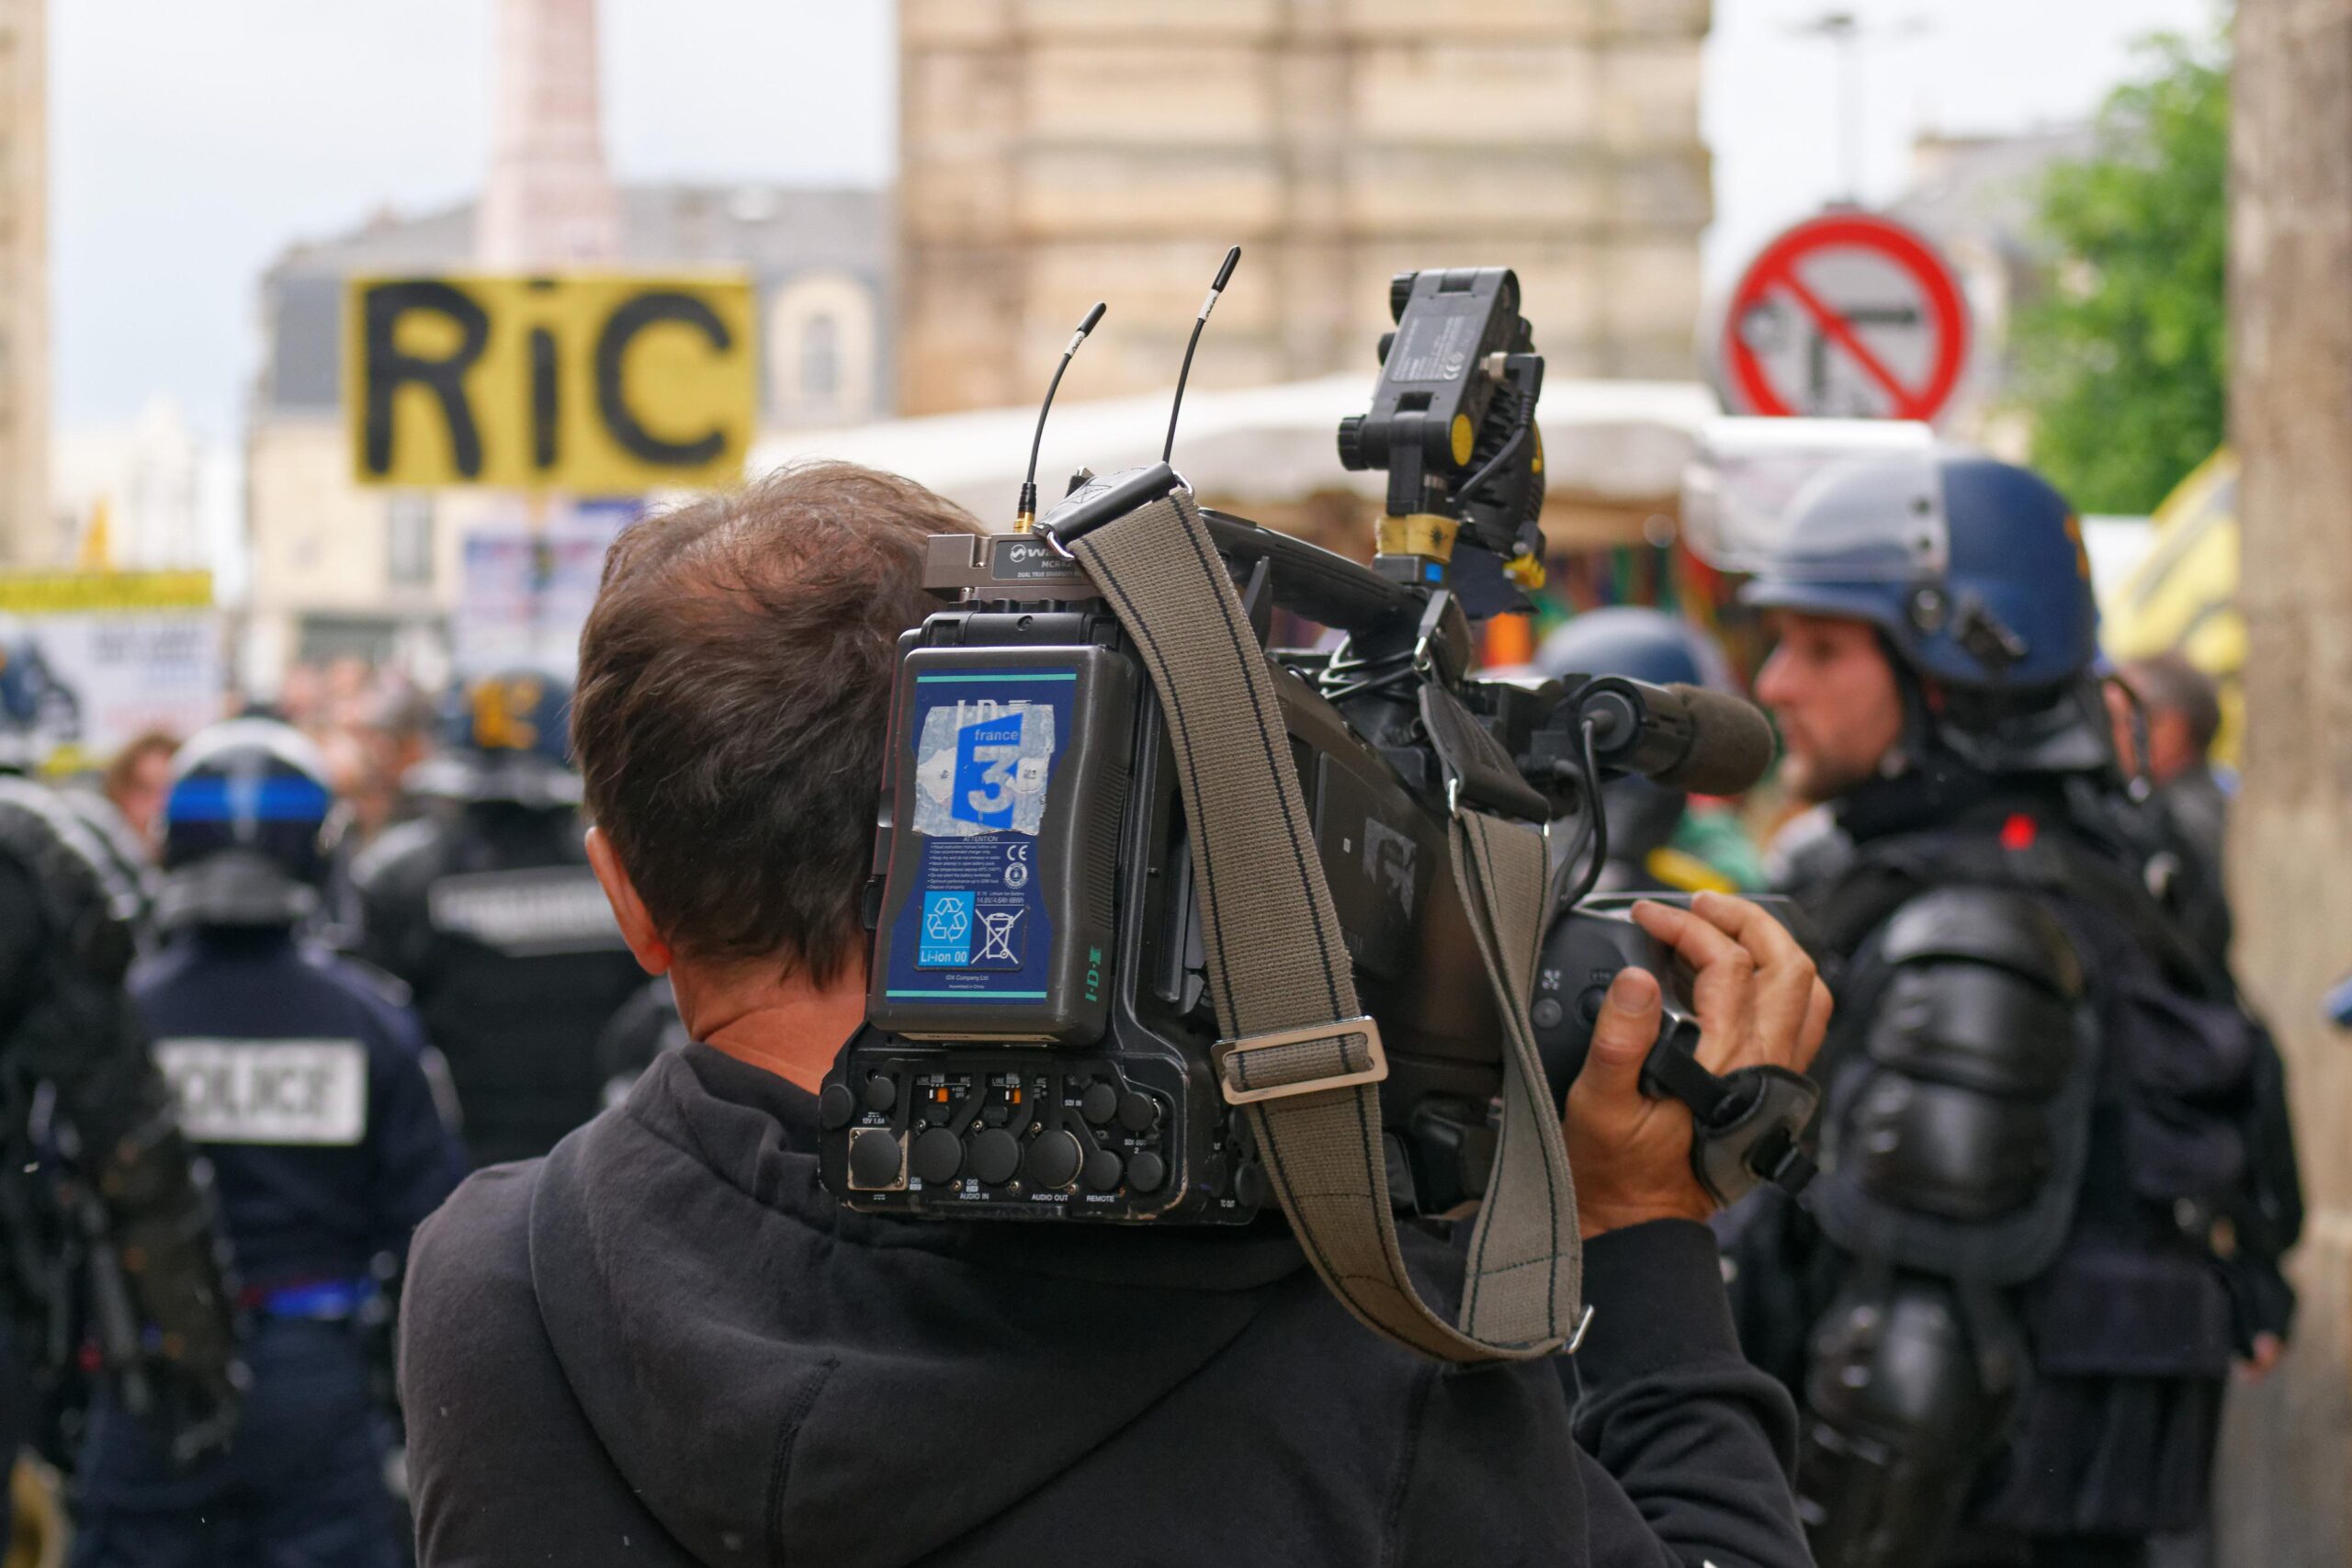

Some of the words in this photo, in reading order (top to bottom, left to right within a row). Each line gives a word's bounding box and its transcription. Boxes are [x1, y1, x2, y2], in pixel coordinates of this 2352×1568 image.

[974, 729, 1019, 740] france
[967, 745, 1019, 813] 3
[921, 950, 951, 963] Li-ion
[955, 951, 967, 963] 00
